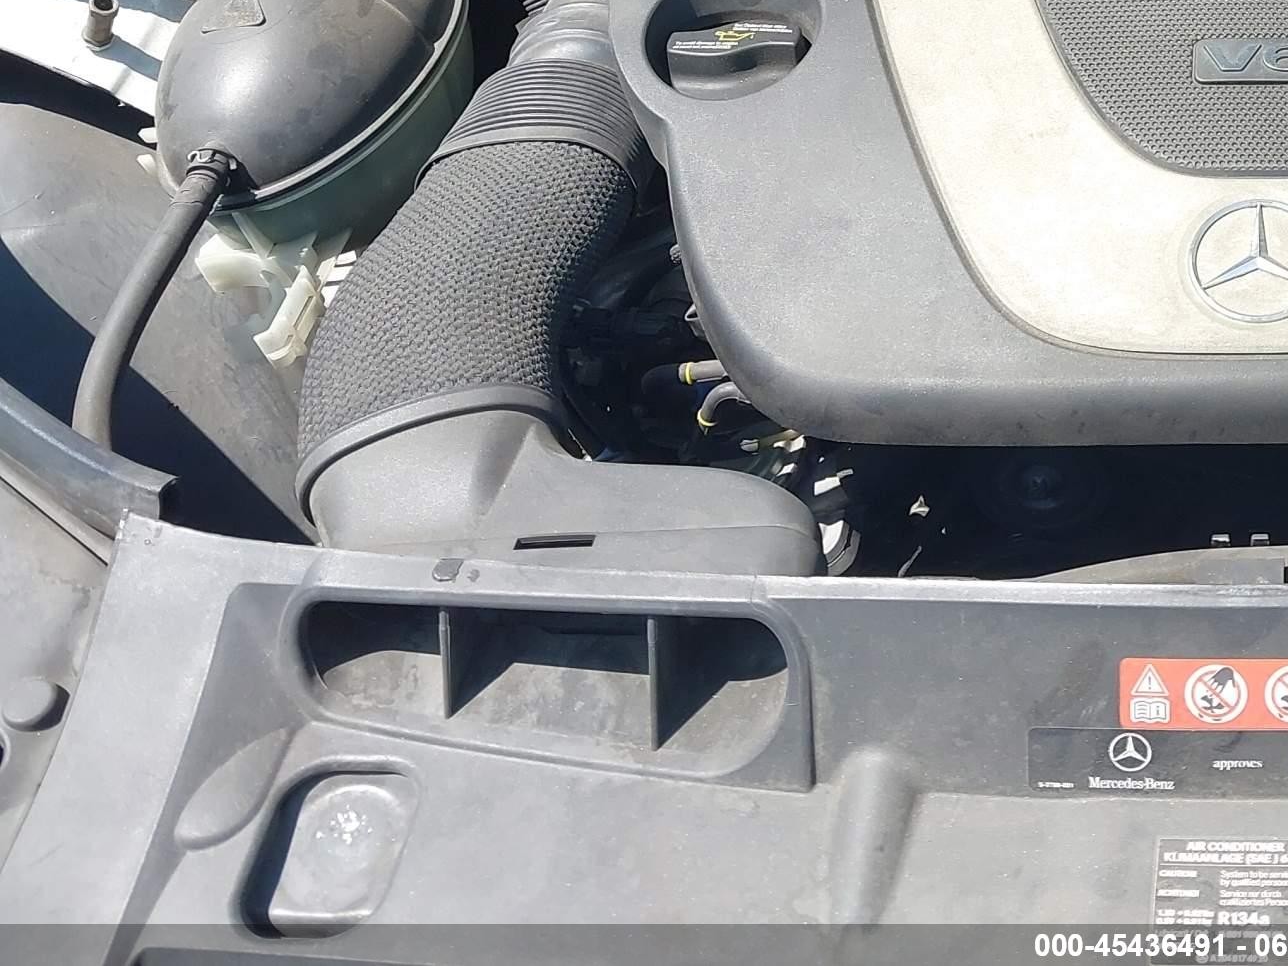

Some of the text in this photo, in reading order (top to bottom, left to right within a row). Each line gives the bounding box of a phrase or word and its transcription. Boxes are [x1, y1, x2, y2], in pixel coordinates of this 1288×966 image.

[1212, 759, 1263, 771] approves
[1088, 776, 1175, 790] Mercedes-Benz
[1186, 841, 1286, 852] AIR CONDITIONER
[1218, 911, 1271, 926] R134a
